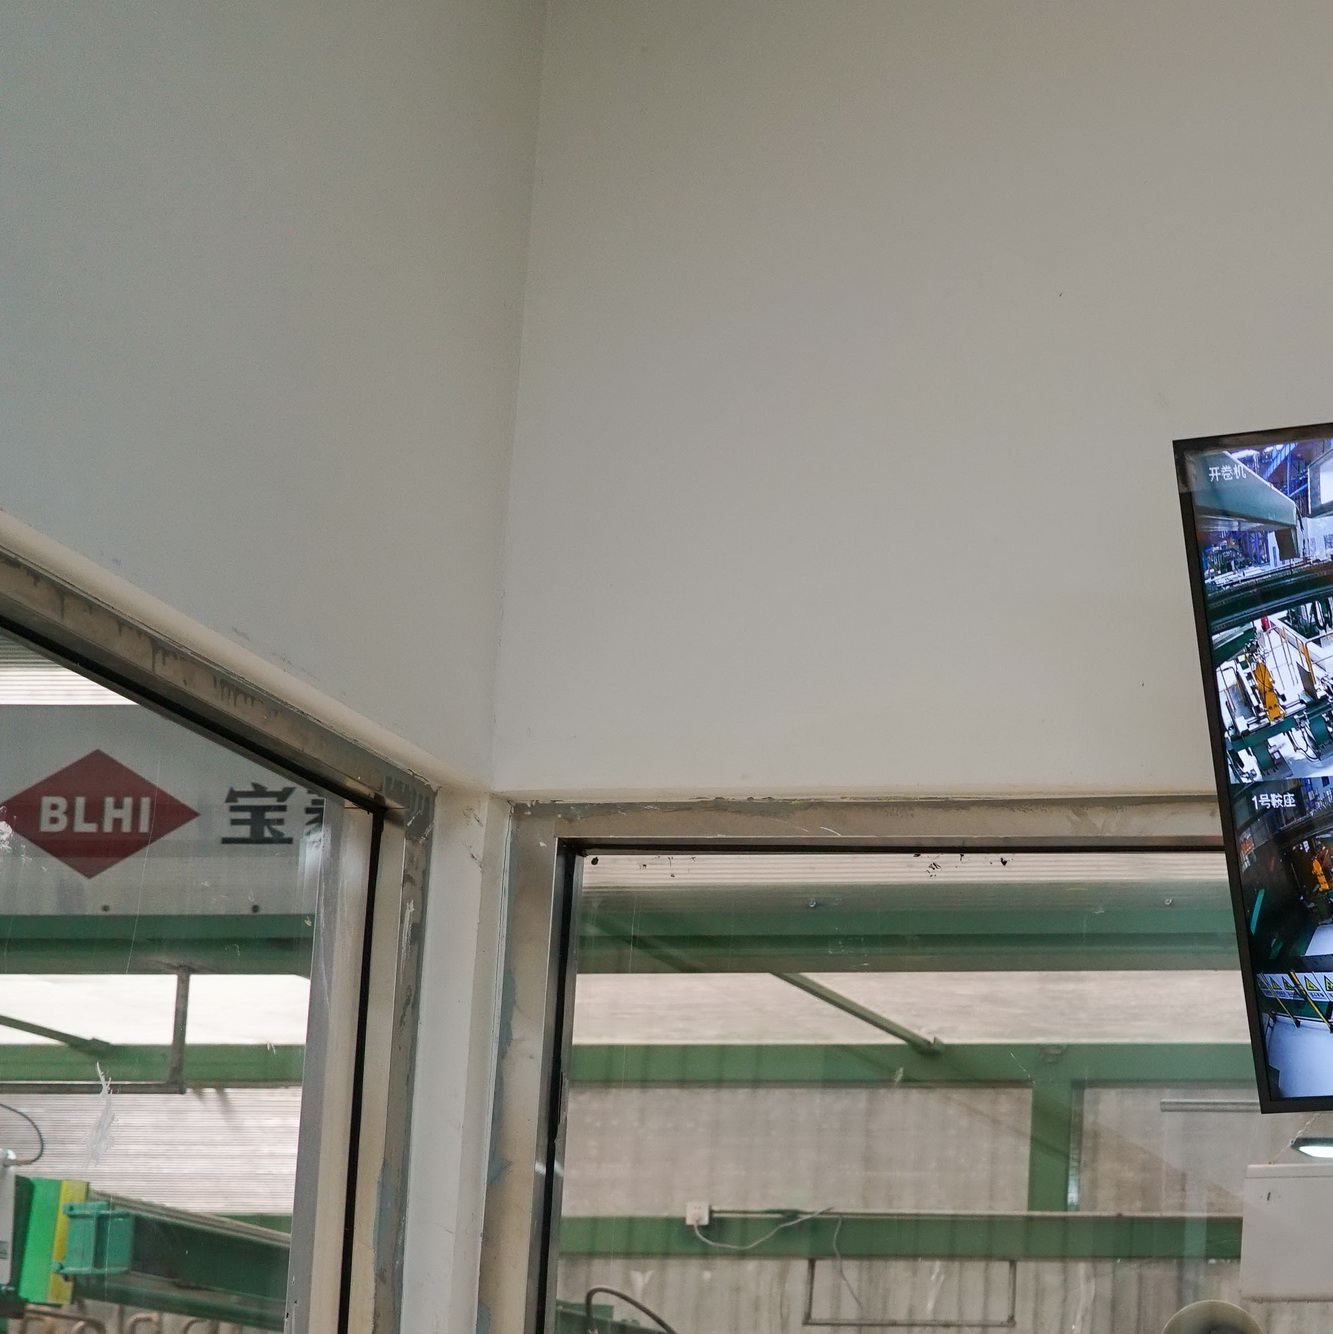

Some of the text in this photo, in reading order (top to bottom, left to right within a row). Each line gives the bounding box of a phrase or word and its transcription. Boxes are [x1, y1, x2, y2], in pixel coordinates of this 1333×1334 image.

[1208, 465, 1246, 482] 开卷机
[1251, 793, 1296, 810] 1号鞍座
[39, 796, 151, 833] BLHI
